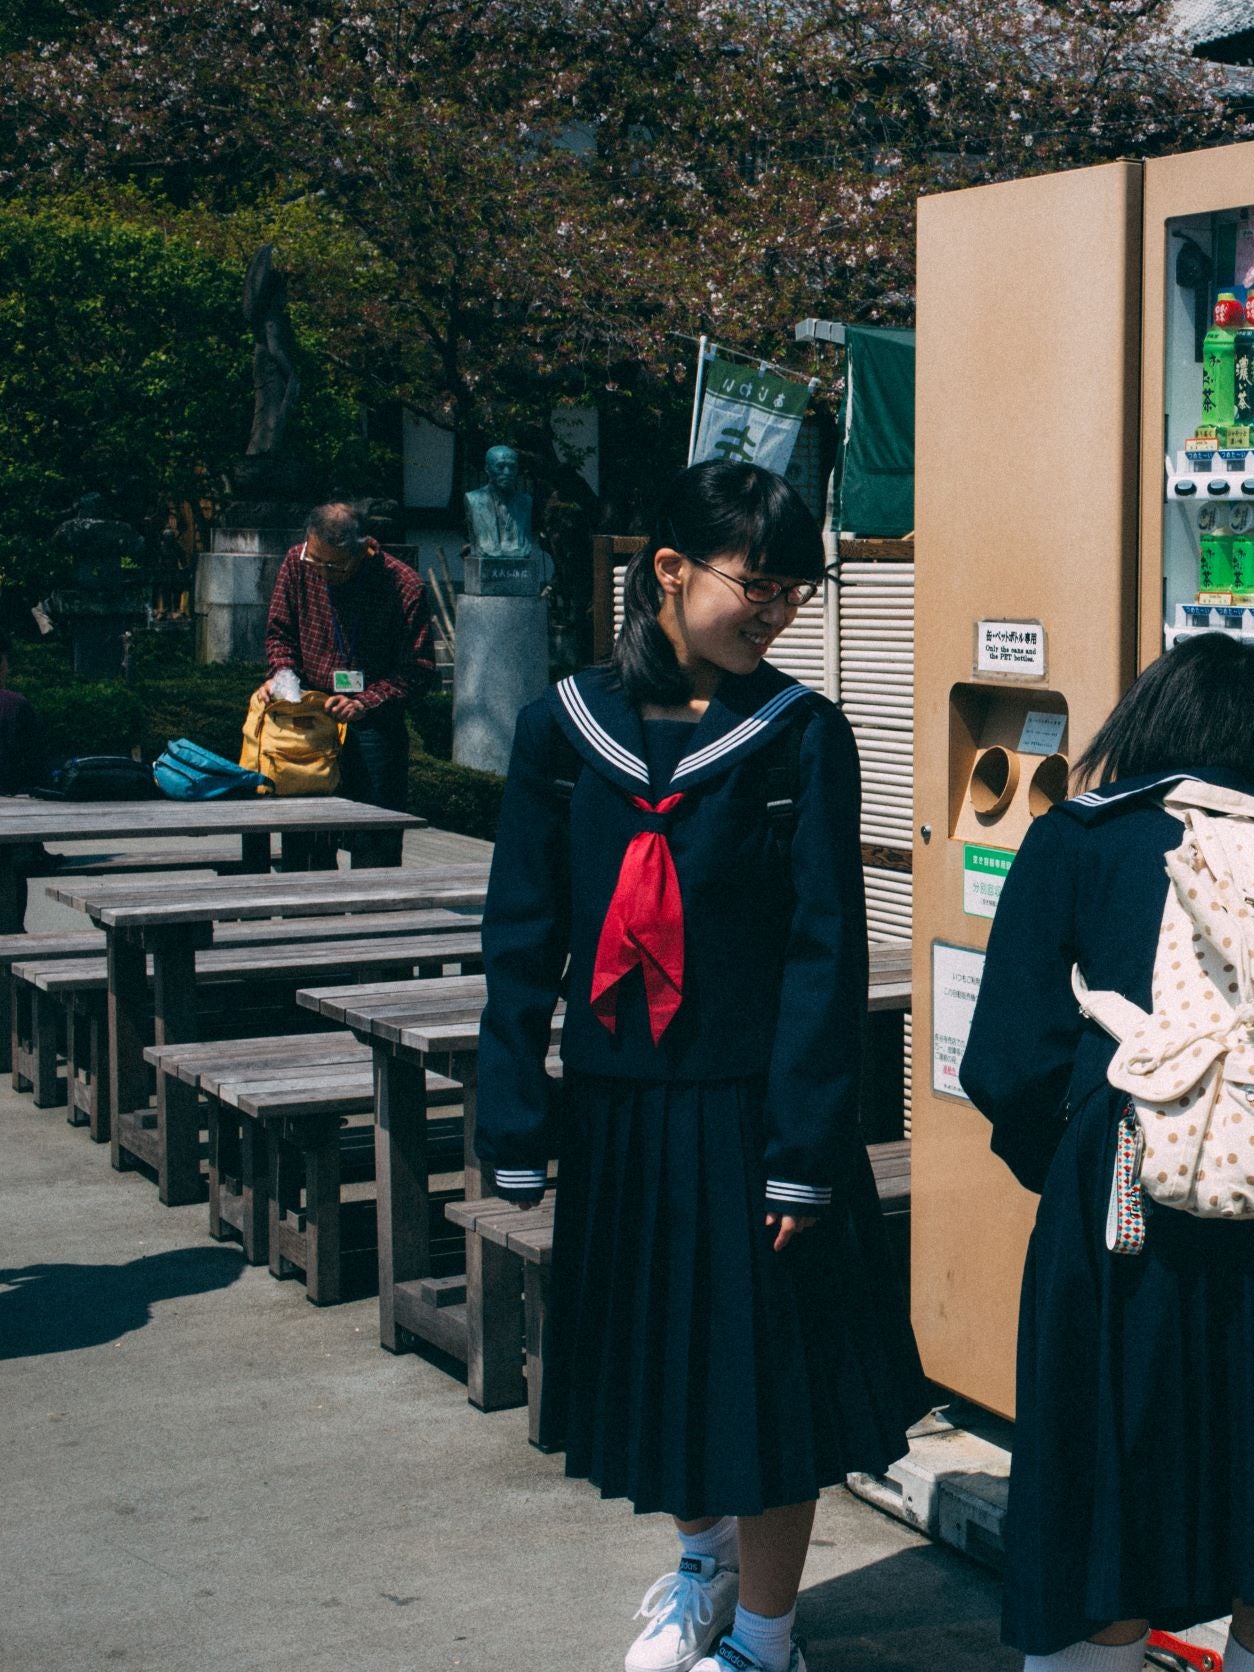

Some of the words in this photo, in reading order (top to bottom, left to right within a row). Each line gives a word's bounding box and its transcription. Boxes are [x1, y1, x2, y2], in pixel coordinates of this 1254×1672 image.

[985, 645, 999, 653] Only
[1025, 647, 1037, 655] and
[1000, 653, 1012, 661] PET
[1014, 654, 1035, 663] bottles.
